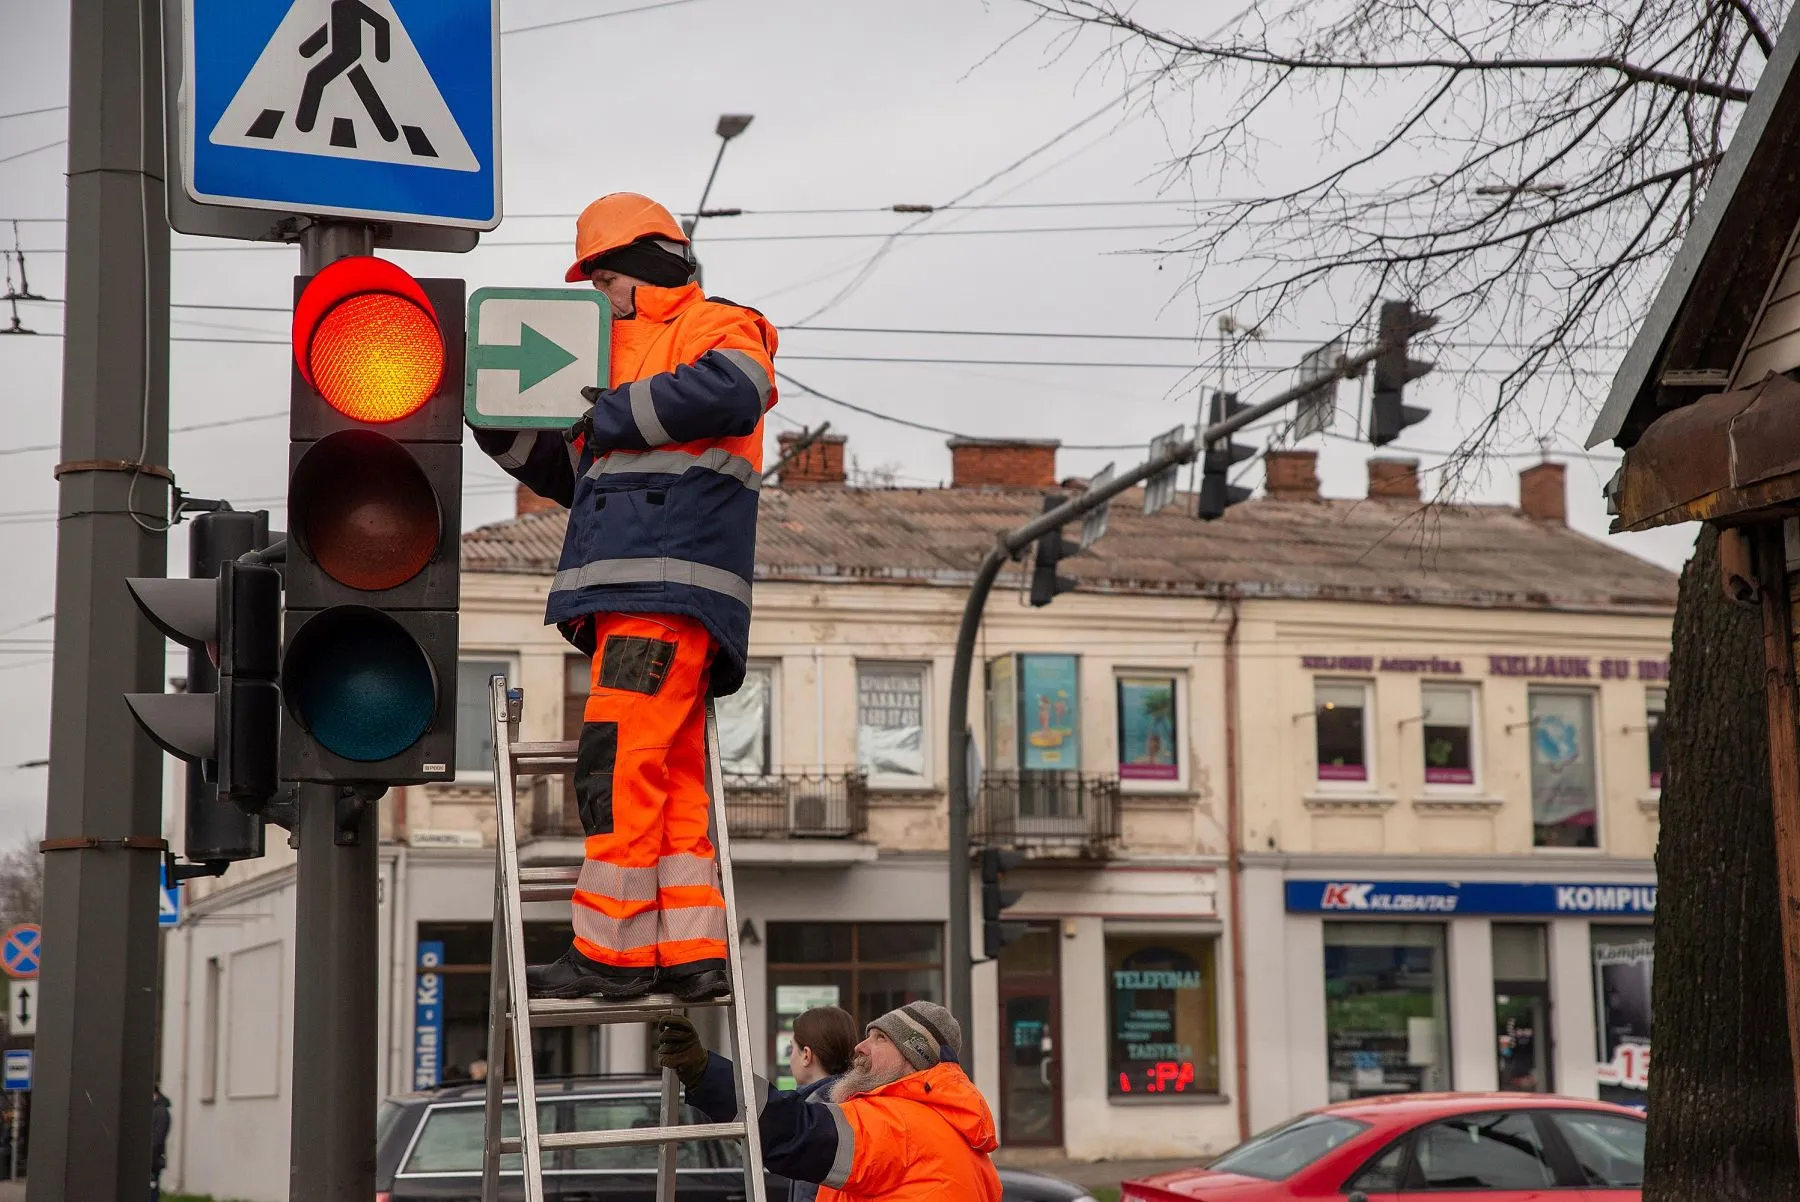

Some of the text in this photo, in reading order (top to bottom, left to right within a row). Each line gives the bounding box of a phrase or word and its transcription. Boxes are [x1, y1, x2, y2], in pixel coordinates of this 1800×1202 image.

[1488, 655, 1592, 677] KELIAUK
[1600, 659, 1630, 680] SU
[1556, 886, 1657, 911] KOMPIU
